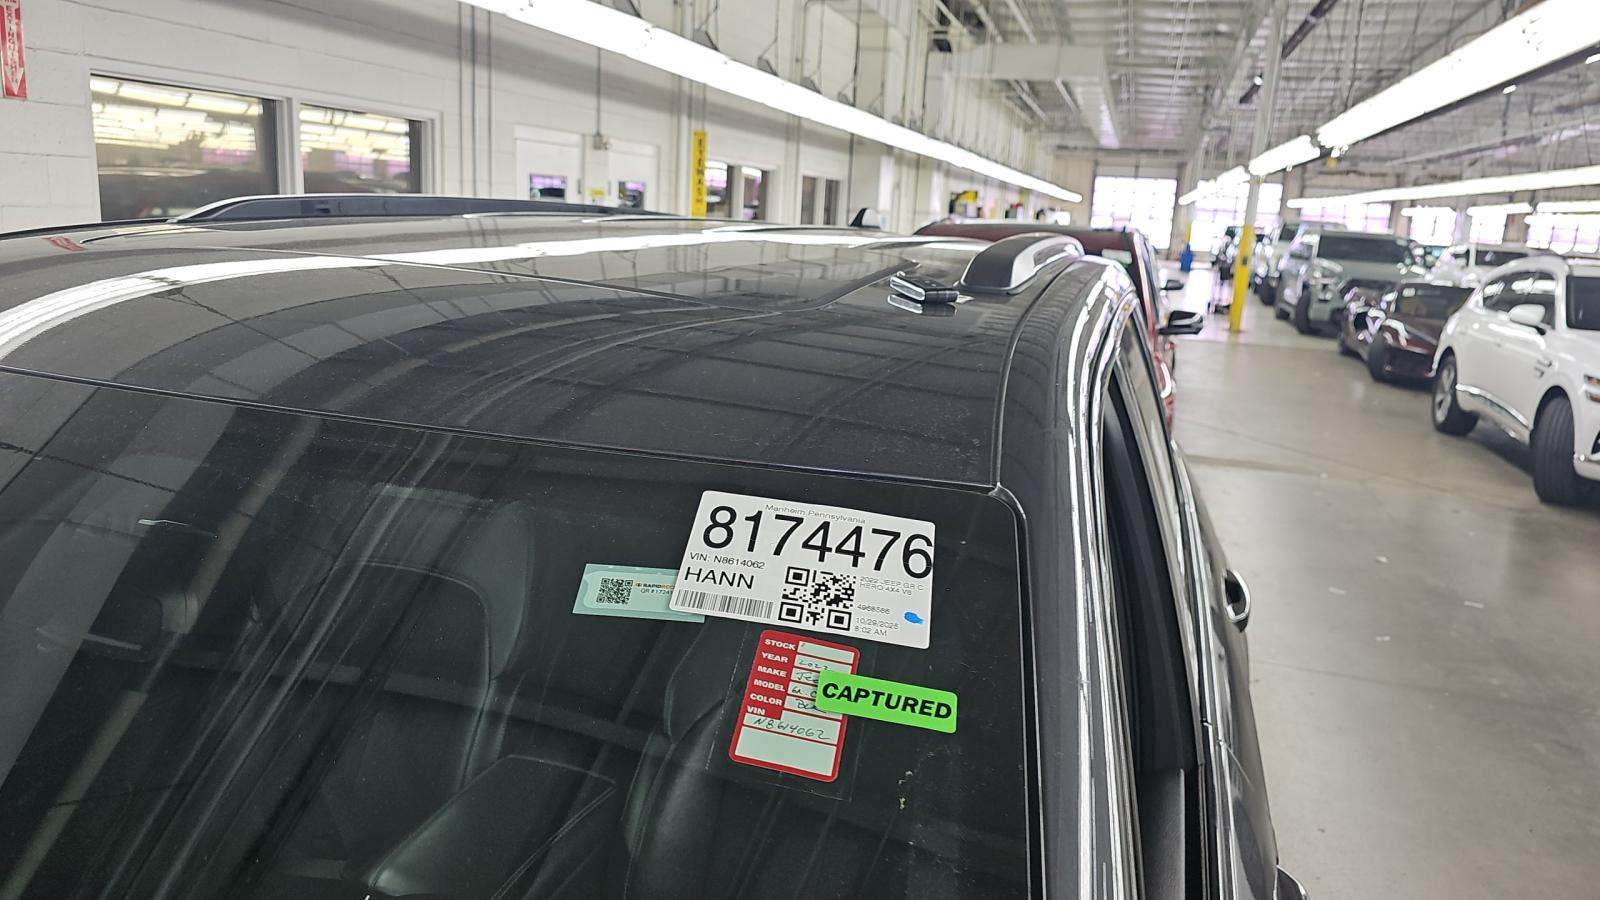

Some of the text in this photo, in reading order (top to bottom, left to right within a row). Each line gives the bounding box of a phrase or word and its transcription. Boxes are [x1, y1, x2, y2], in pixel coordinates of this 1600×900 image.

[765, 504, 866, 524] Manheim Pennsylvania
[702, 505, 934, 579] 8174476
[689, 552, 766, 569] VIN: N8614062
[684, 566, 755, 590] HANN
[881, 579, 902, 587] JEEP
[873, 628, 887, 637] AM
[764, 638, 797, 651] STOCK
[761, 650, 789, 664] YEAR
[757, 665, 788, 678] MAKE
[753, 678, 786, 693] MODEL
[749, 692, 783, 706] COLOR
[822, 682, 952, 720] CAPTURED
[746, 705, 766, 717] VIN
